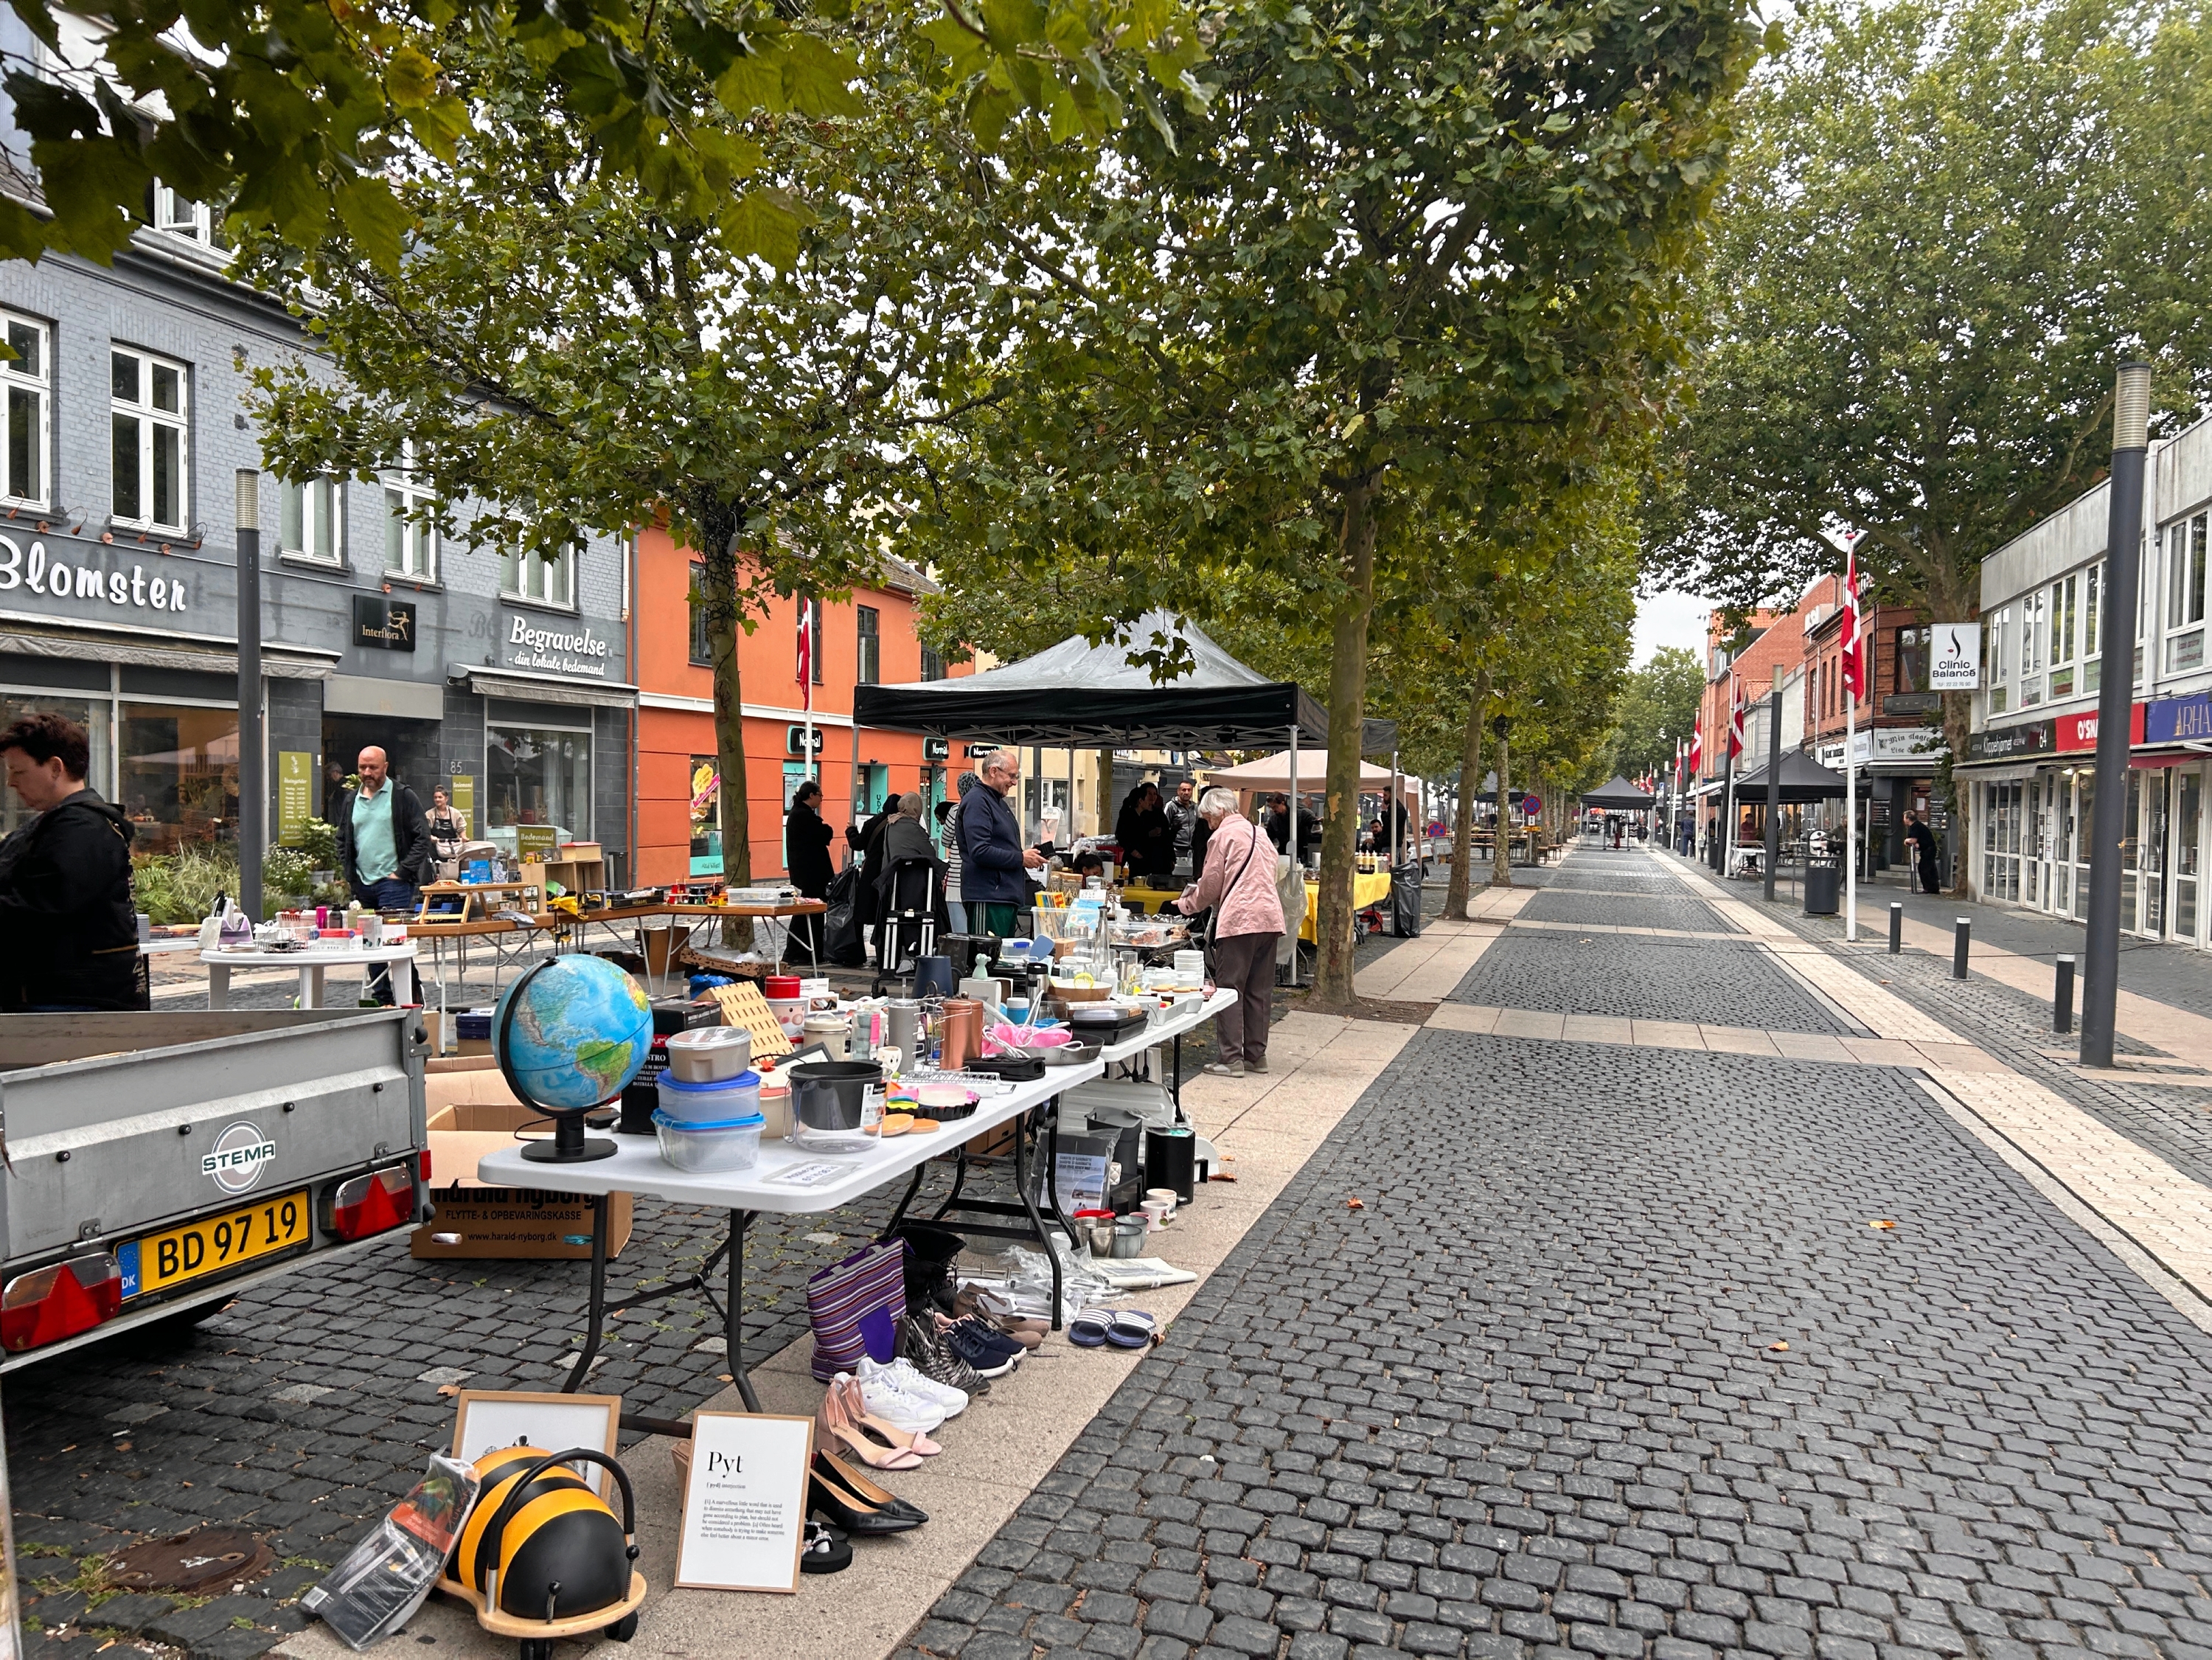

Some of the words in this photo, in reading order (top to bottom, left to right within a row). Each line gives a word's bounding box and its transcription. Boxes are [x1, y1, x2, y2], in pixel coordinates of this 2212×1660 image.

[0, 534, 187, 611] Blomster
[362, 625, 400, 640] Interflora
[509, 615, 606, 656] Begravelse
[515, 650, 530, 666] din
[532, 653, 561, 671] lokale
[562, 660, 605, 676] bedemand
[1938, 660, 1970, 669] Clinic
[799, 732, 821, 747] Nomal
[1889, 735, 1905, 745] Min
[932, 742, 948, 755] Normal
[450, 761, 462, 774] 85
[521, 833, 554, 842] Bedemand
[203, 1143, 274, 1172] STEMA
[482, 1211, 488, 1220] &
[490, 1210, 582, 1220] OPBEVARINGSKASSE
[158, 1232, 204, 1279] BD
[214, 1214, 252, 1261] 97
[265, 1201, 296, 1245] 19
[467, 1232, 557, 1243] www.harald-nyborg.dk
[122, 1274, 136, 1288] DK
[708, 1451, 743, 1478] Pyt
